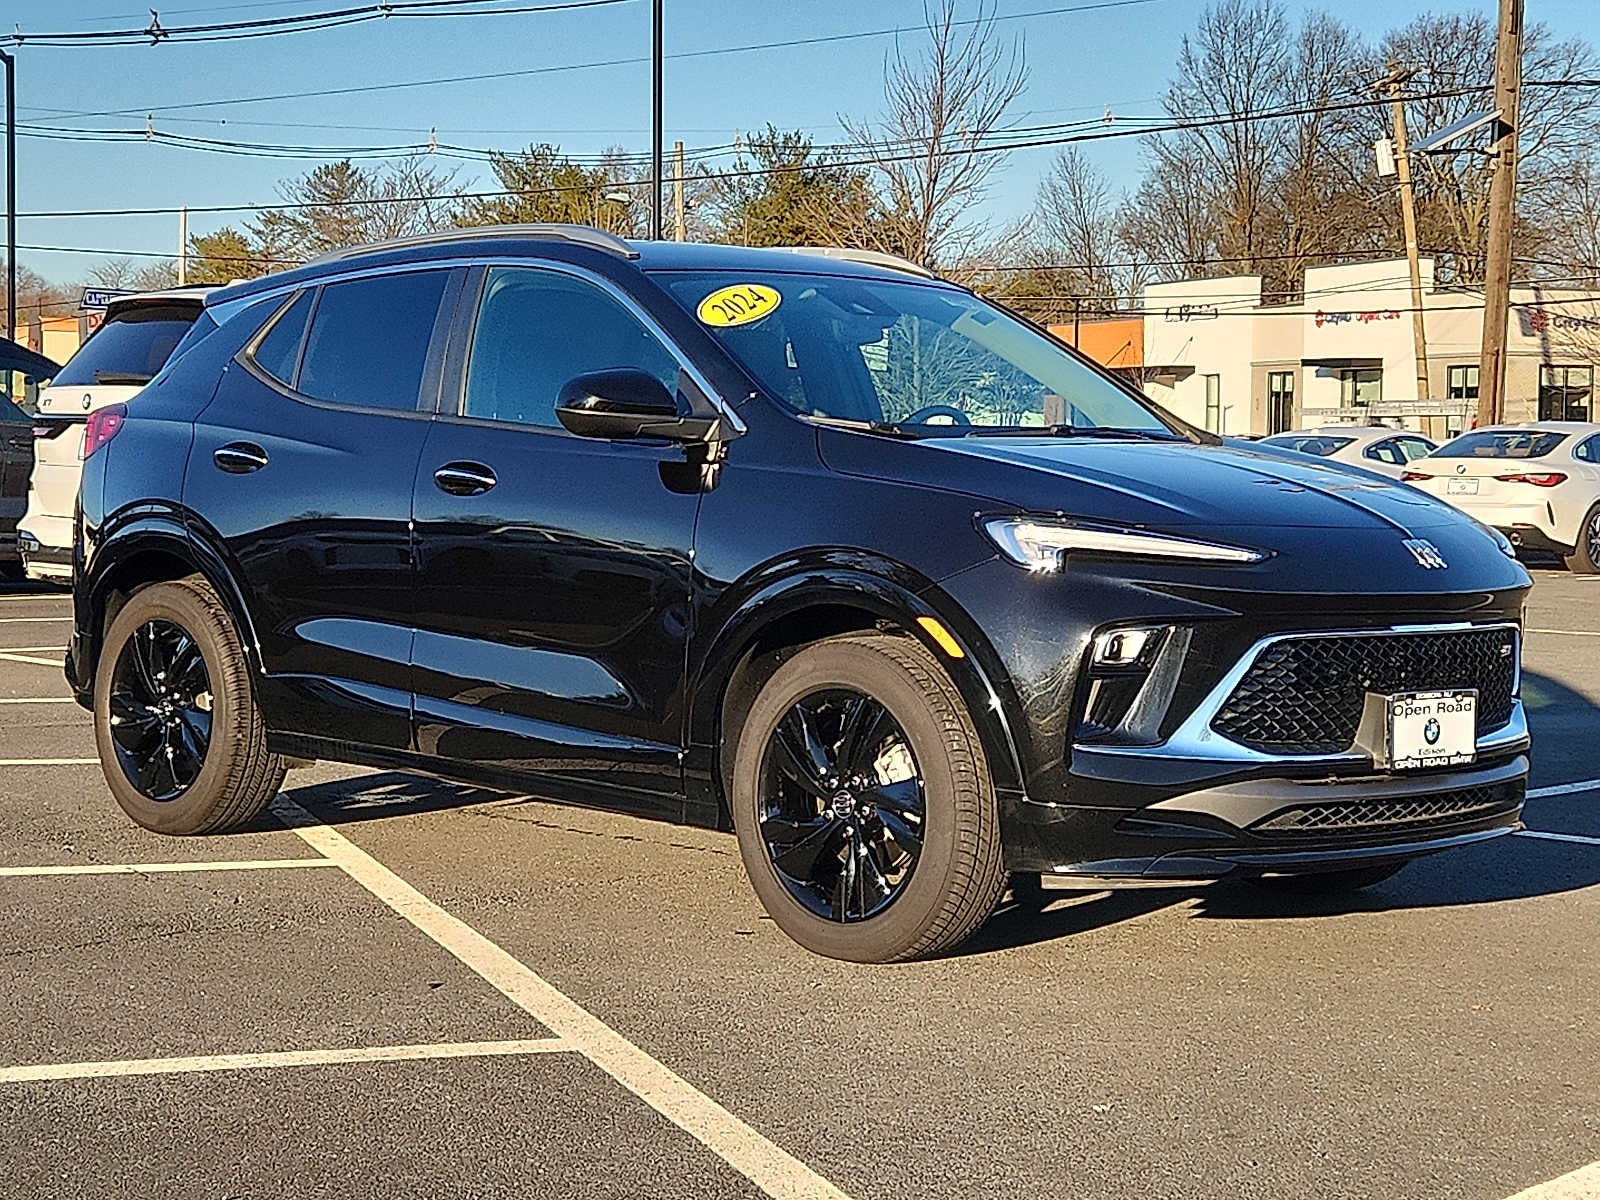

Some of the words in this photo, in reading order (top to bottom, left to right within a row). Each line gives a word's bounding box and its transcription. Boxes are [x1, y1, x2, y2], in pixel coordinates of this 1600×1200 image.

[711, 287, 768, 322] 2024
[1392, 704, 1431, 718] Open
[1436, 700, 1471, 713] Road
[1394, 758, 1420, 769] OPEN
[1422, 756, 1448, 767] ROAD
